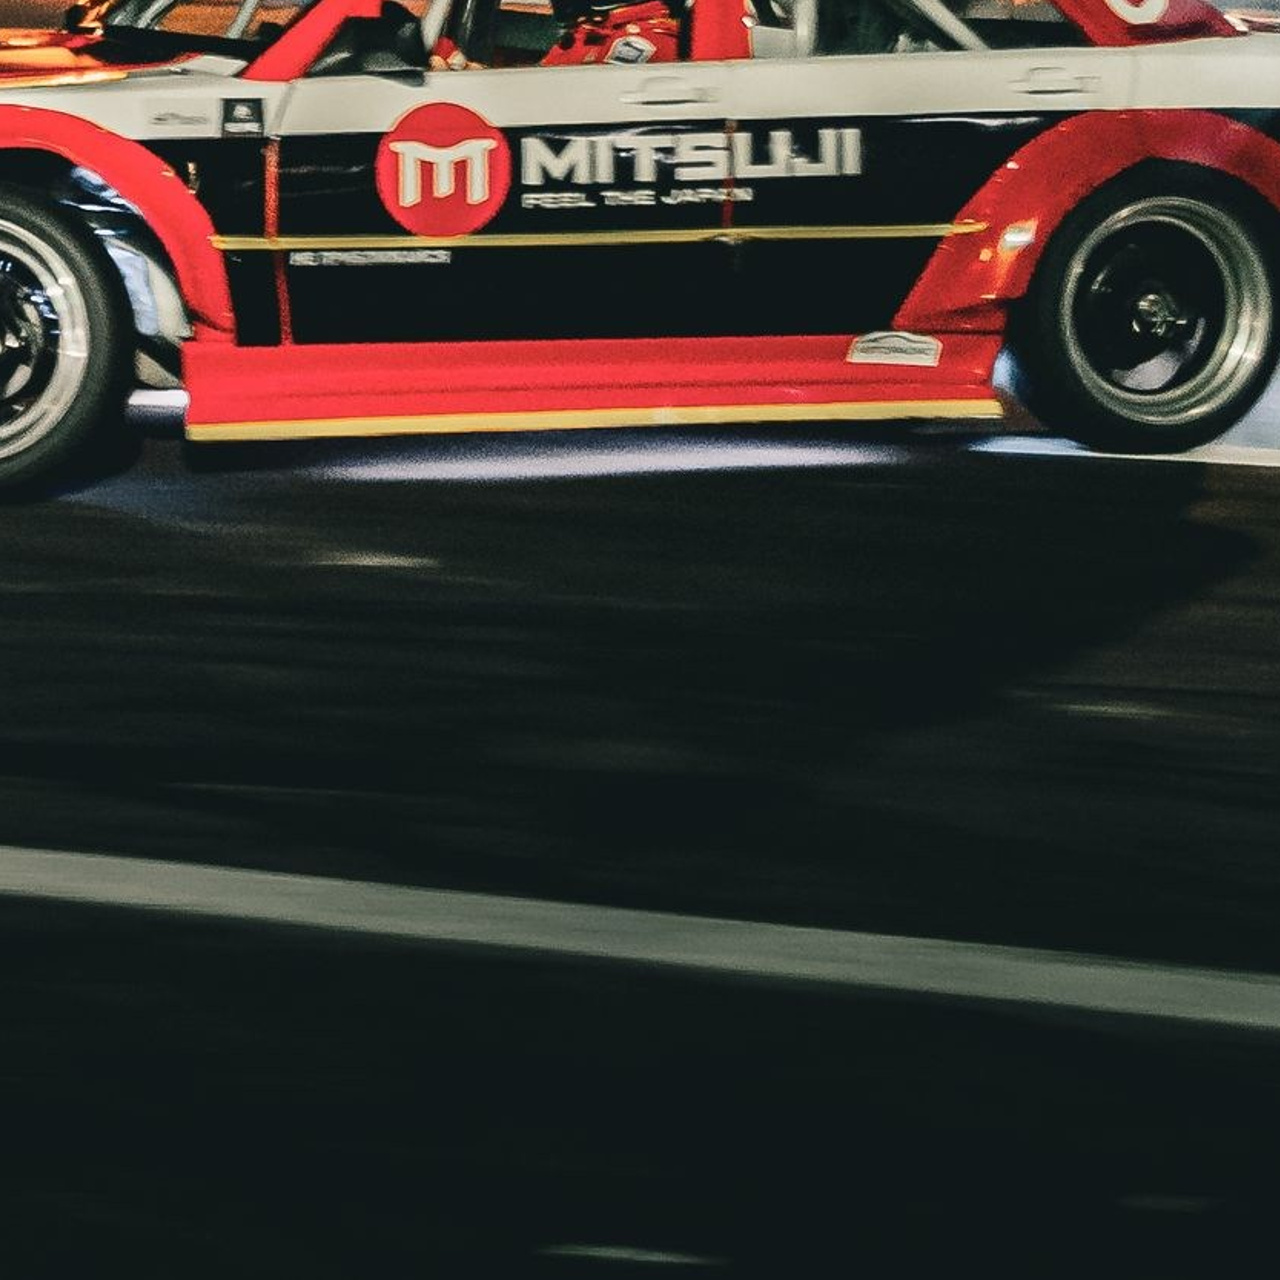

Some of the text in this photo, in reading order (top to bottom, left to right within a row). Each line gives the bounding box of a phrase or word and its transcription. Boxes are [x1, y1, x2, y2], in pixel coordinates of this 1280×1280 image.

[521, 128, 861, 185] MITSUJI
[521, 192, 596, 208] FEEL
[600, 190, 656, 205] THE
